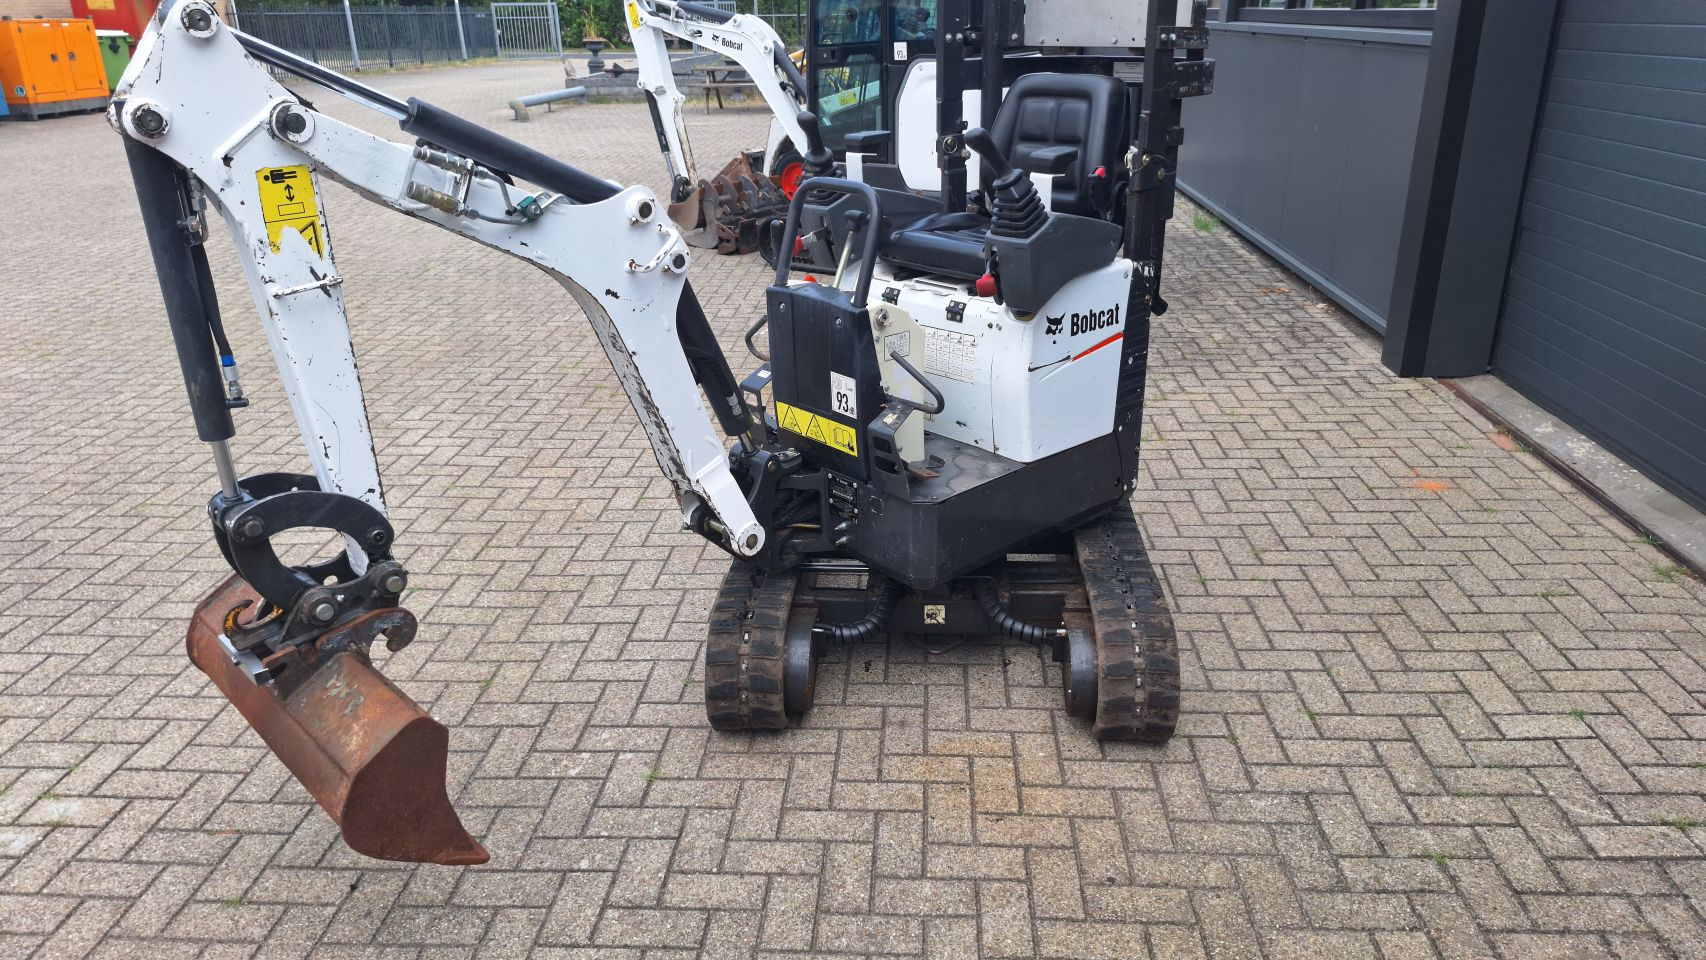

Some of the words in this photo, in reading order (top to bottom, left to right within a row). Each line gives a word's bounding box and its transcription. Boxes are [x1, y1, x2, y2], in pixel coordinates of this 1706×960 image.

[721, 37, 743, 51] Bobcat
[1070, 303, 1120, 337] Bobcat
[836, 391, 849, 413] 93
